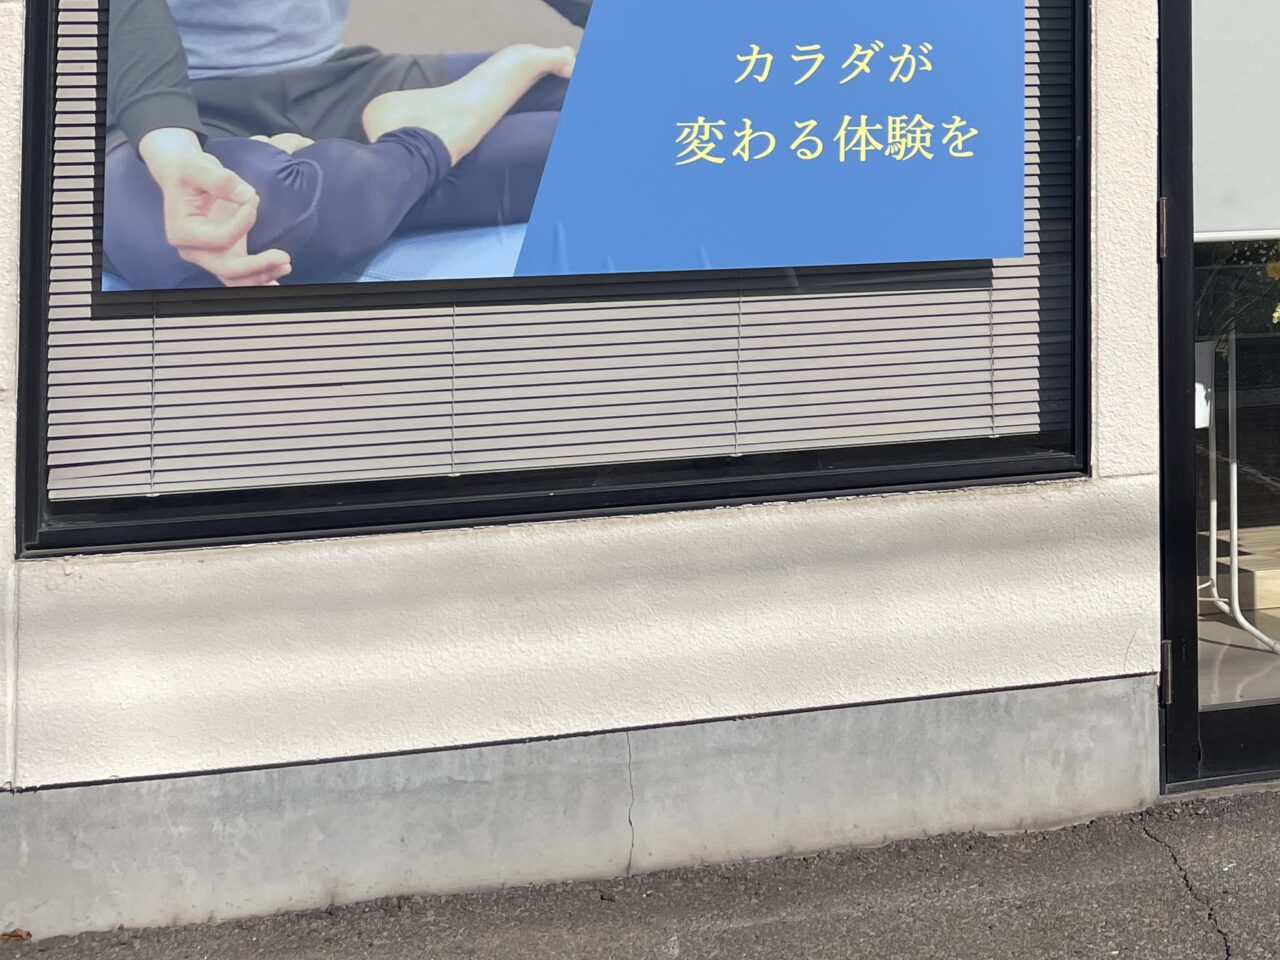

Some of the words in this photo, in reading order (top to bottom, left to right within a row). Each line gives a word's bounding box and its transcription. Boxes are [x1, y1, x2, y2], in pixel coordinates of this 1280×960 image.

[734, 39, 933, 85] カラダが
[675, 114, 979, 166] 変わる体験を
